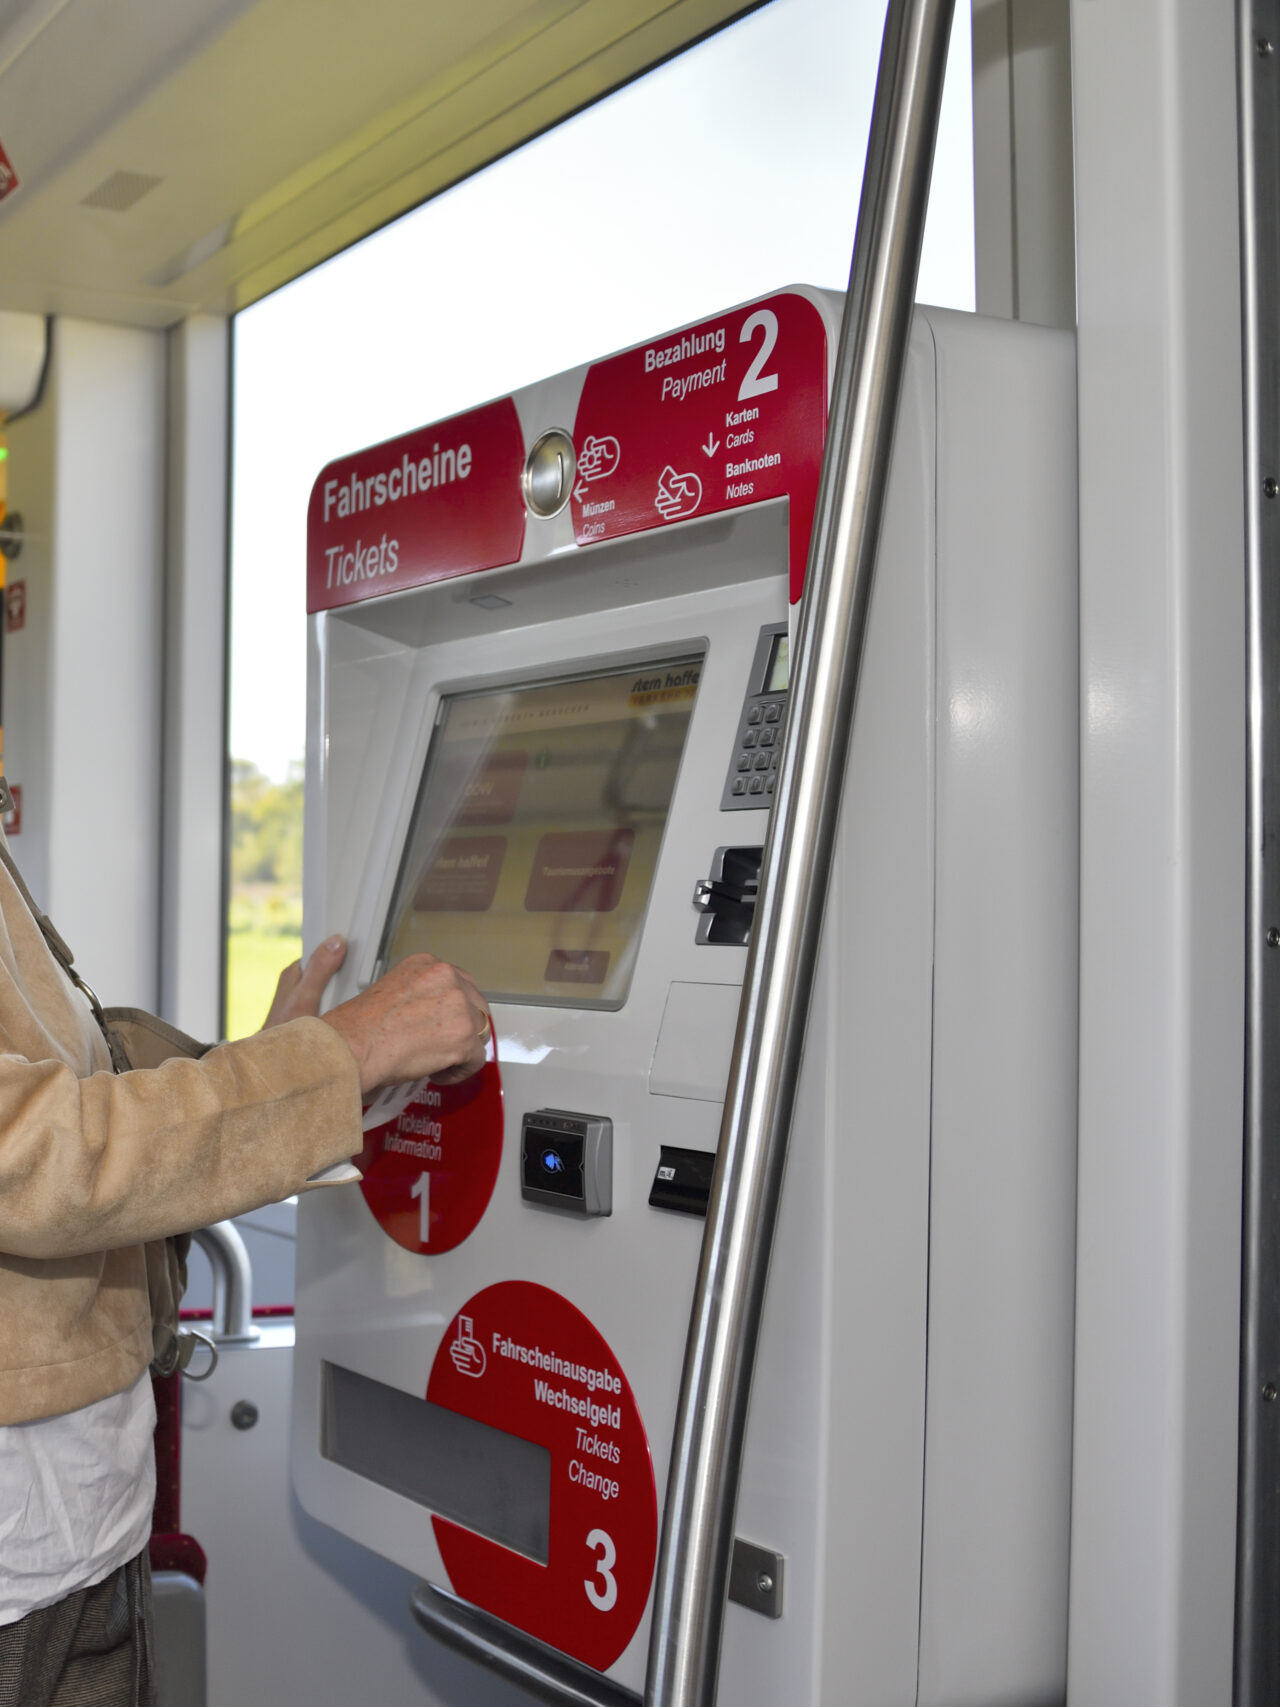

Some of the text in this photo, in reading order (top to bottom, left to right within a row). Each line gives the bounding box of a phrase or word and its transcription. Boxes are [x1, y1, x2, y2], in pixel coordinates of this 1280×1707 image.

[645, 325, 725, 373] Bezahlung
[737, 309, 779, 402] 2
[661, 358, 727, 402] Payment
[725, 407, 760, 428] Karten
[725, 428, 755, 449] Cards
[323, 443, 472, 522] Fahrscheine
[725, 452, 781, 479] Banknoten
[581, 500, 616, 519] Münzen
[725, 482, 755, 500] Notes
[582, 521, 606, 539] Coins
[325, 540, 399, 590] Tickets
[384, 1131, 442, 1161] Information
[397, 1113, 442, 1143] Ticketing
[411, 1171, 430, 1243] 1
[492, 1332, 622, 1395] Fahrscheinausgabe
[534, 1378, 621, 1430] Wechselgeld
[575, 1427, 621, 1464] Tickets
[568, 1459, 620, 1501] Change
[583, 1528, 618, 1612] 3
